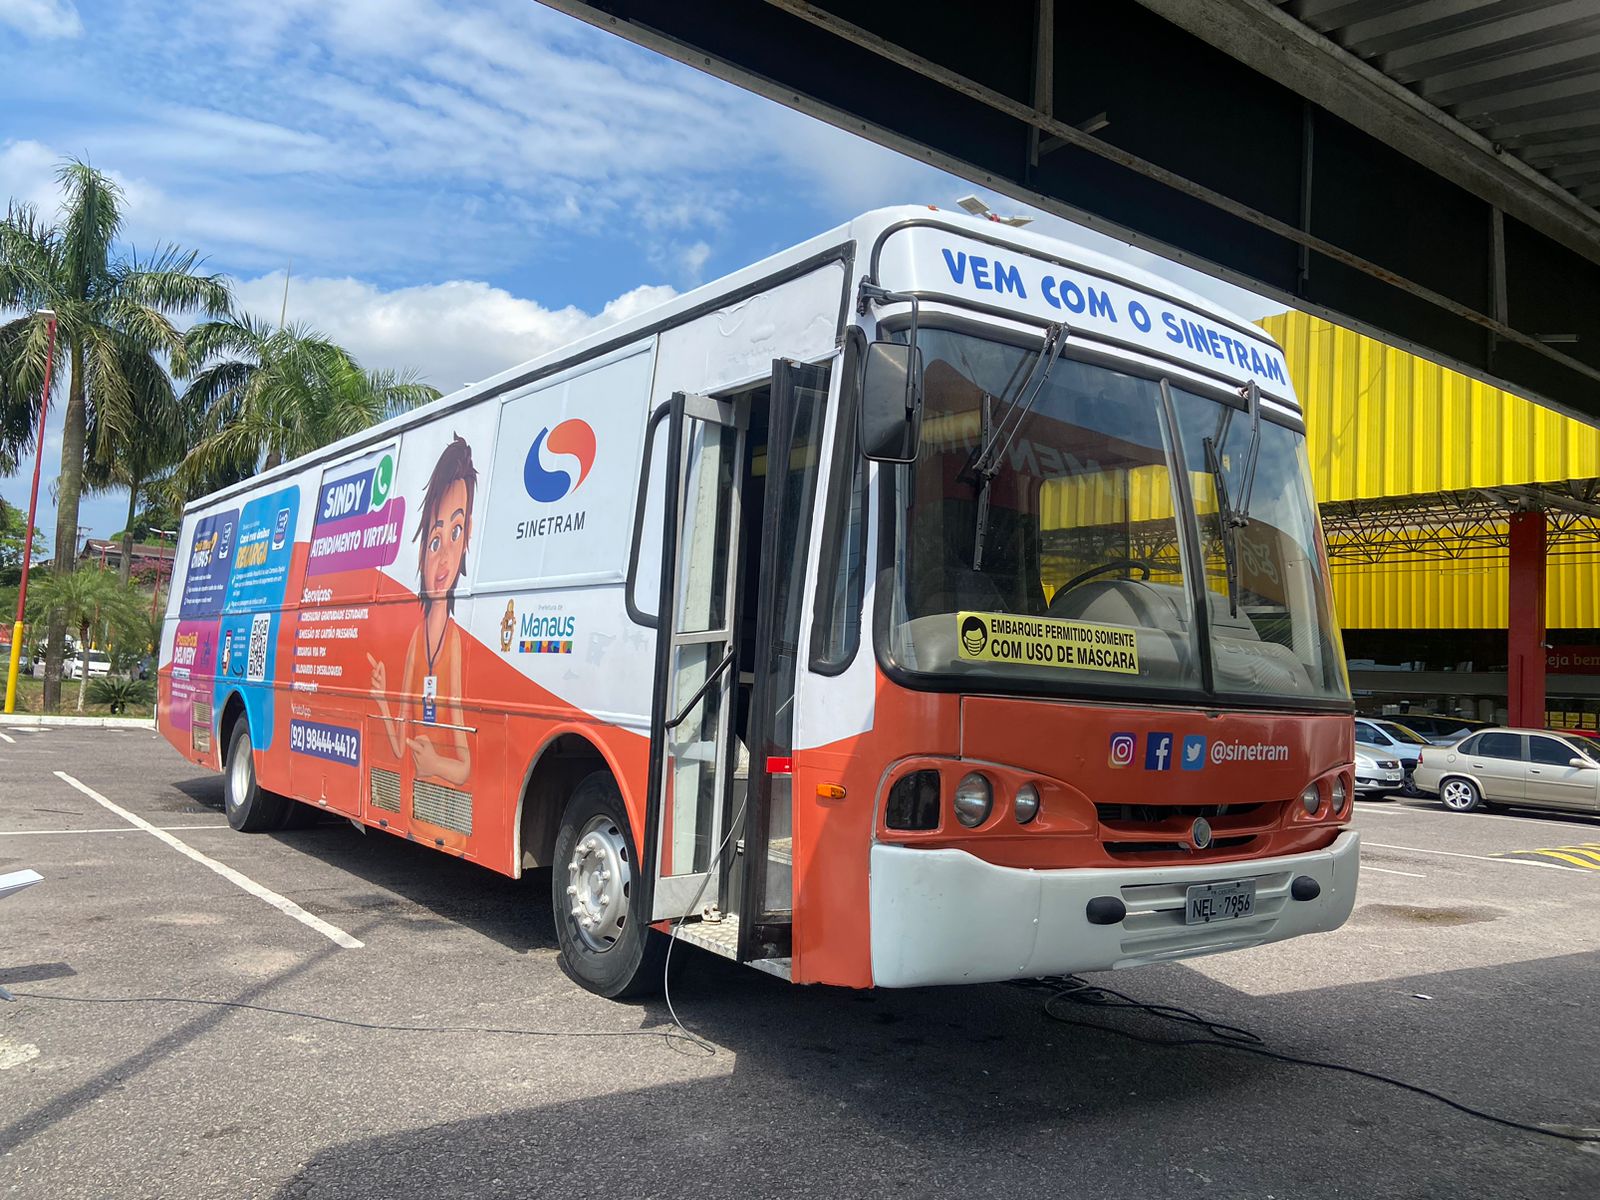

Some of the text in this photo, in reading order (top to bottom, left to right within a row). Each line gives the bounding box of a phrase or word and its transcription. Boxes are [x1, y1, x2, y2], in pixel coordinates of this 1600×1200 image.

[942, 248, 1286, 386] VEM COM O SINETRAM
[323, 478, 366, 519] SINDY
[310, 522, 398, 558] ATENDIMENTO VIRTUAL
[516, 511, 586, 540] SINETRAM
[520, 613, 576, 638] Manaus
[991, 619, 1135, 648] EMBARQUE PERMITIDO SOMENTE
[991, 639, 1136, 670] COM USO DE MÁSCARA
[1545, 654, 1569, 669] eja
[290, 723, 357, 760] (92) 98444-4412
[1210, 739, 1289, 765] @sinetram
